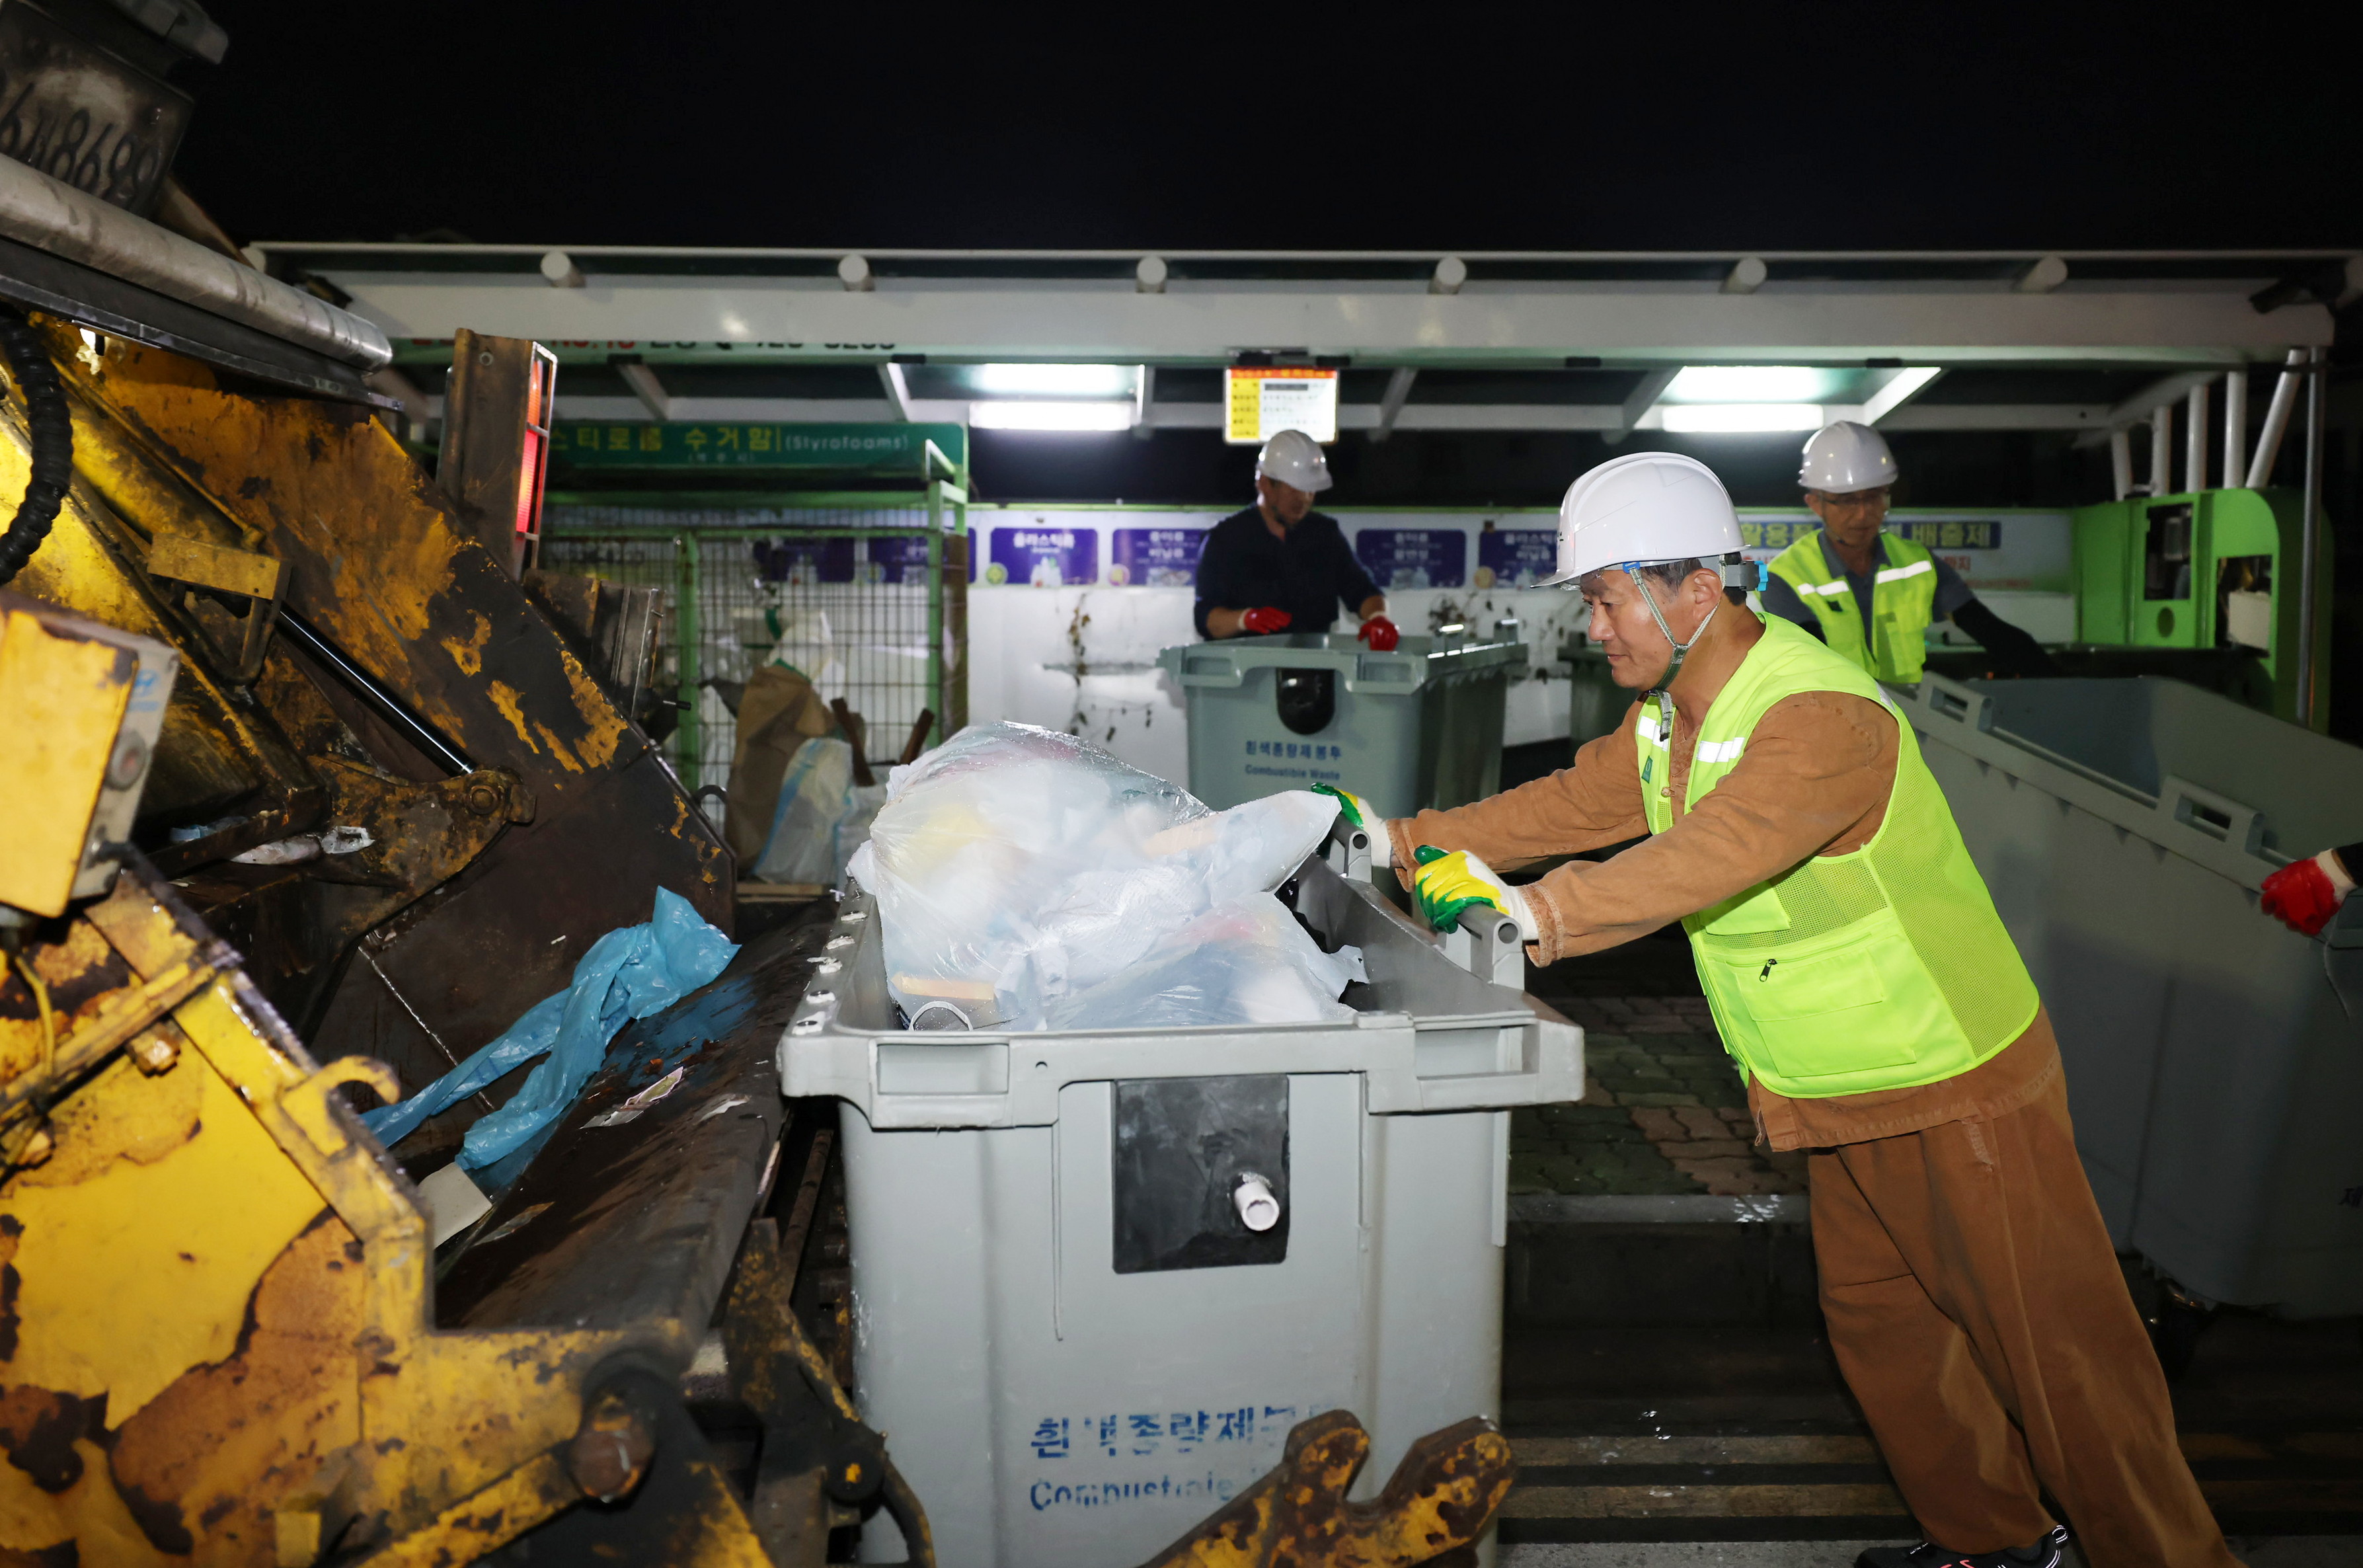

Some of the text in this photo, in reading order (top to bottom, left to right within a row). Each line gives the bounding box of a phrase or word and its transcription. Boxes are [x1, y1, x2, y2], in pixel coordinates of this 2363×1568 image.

[684, 426, 772, 451] 수거함
[1912, 523, 1991, 548] 배출제
[1245, 764, 1341, 781] Combustible Waste
